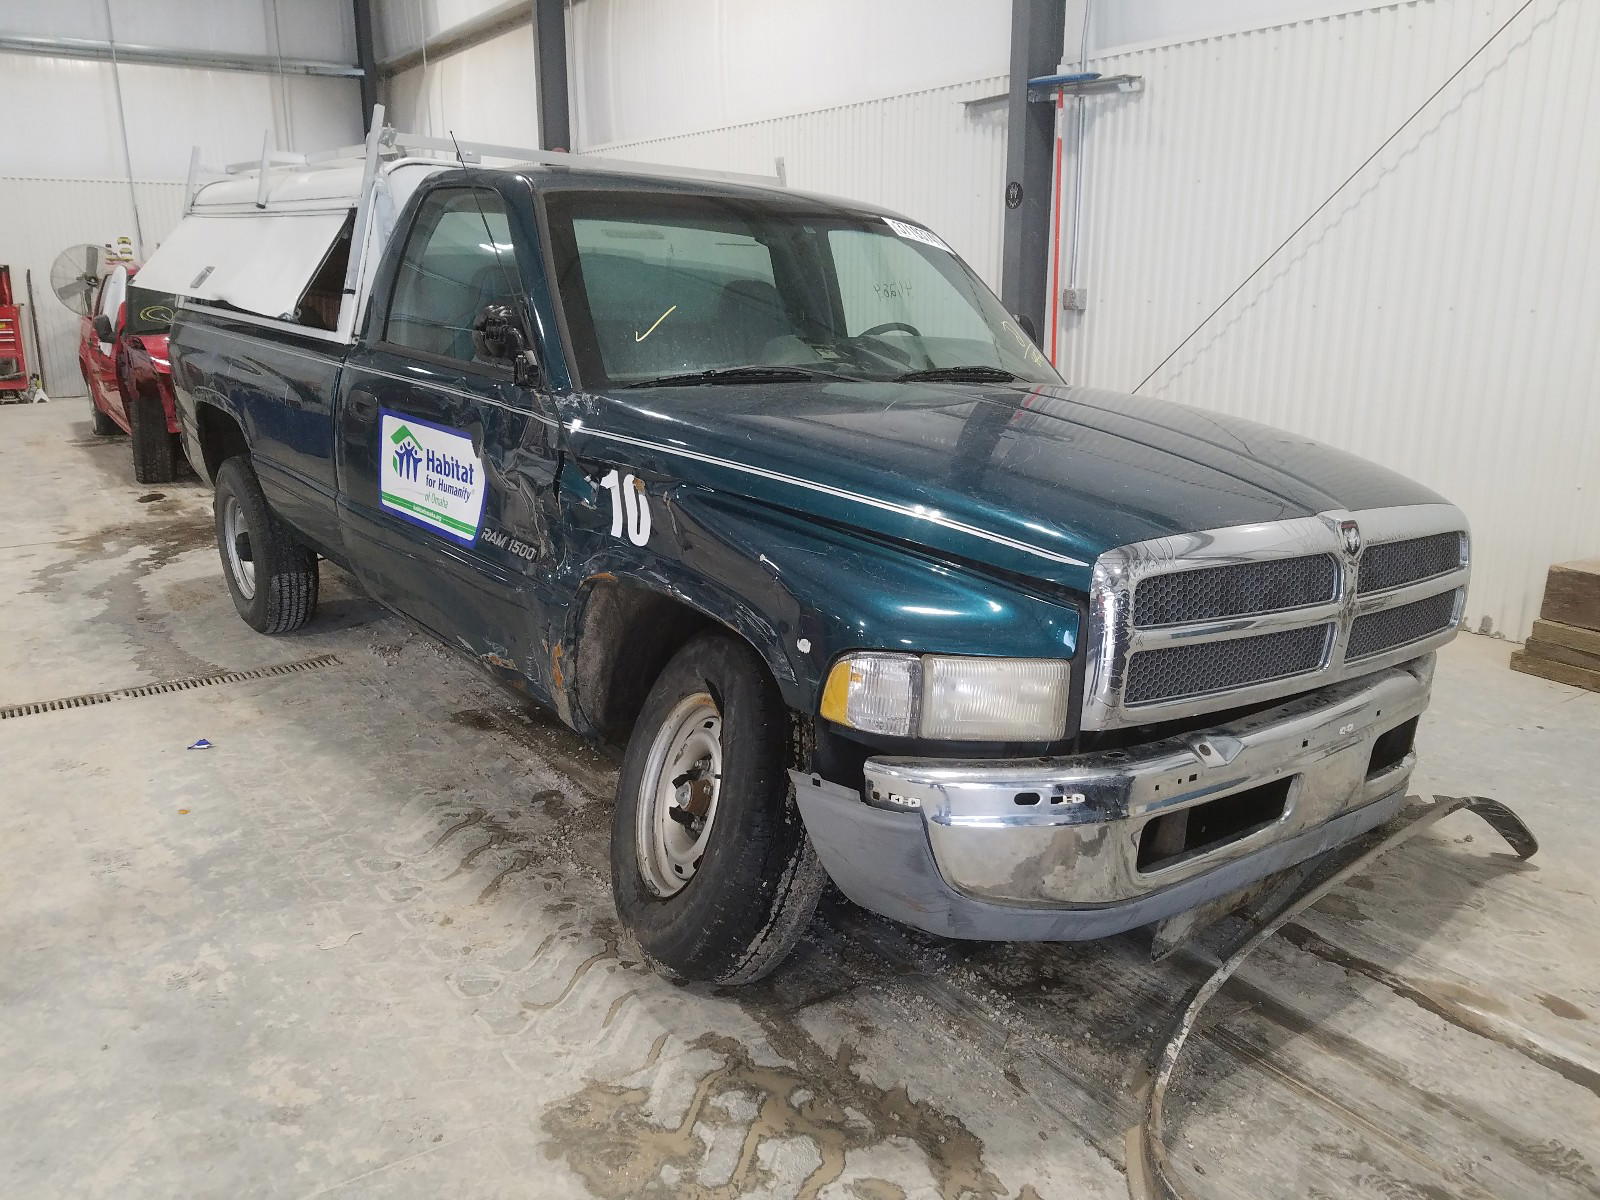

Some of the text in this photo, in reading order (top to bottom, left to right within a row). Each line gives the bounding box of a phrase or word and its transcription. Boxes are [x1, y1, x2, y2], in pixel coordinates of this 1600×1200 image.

[426, 448, 474, 486] Habitat
[425, 474, 472, 504] for Humanity
[600, 469, 652, 547] 10
[481, 527, 537, 561] RAM 1500
